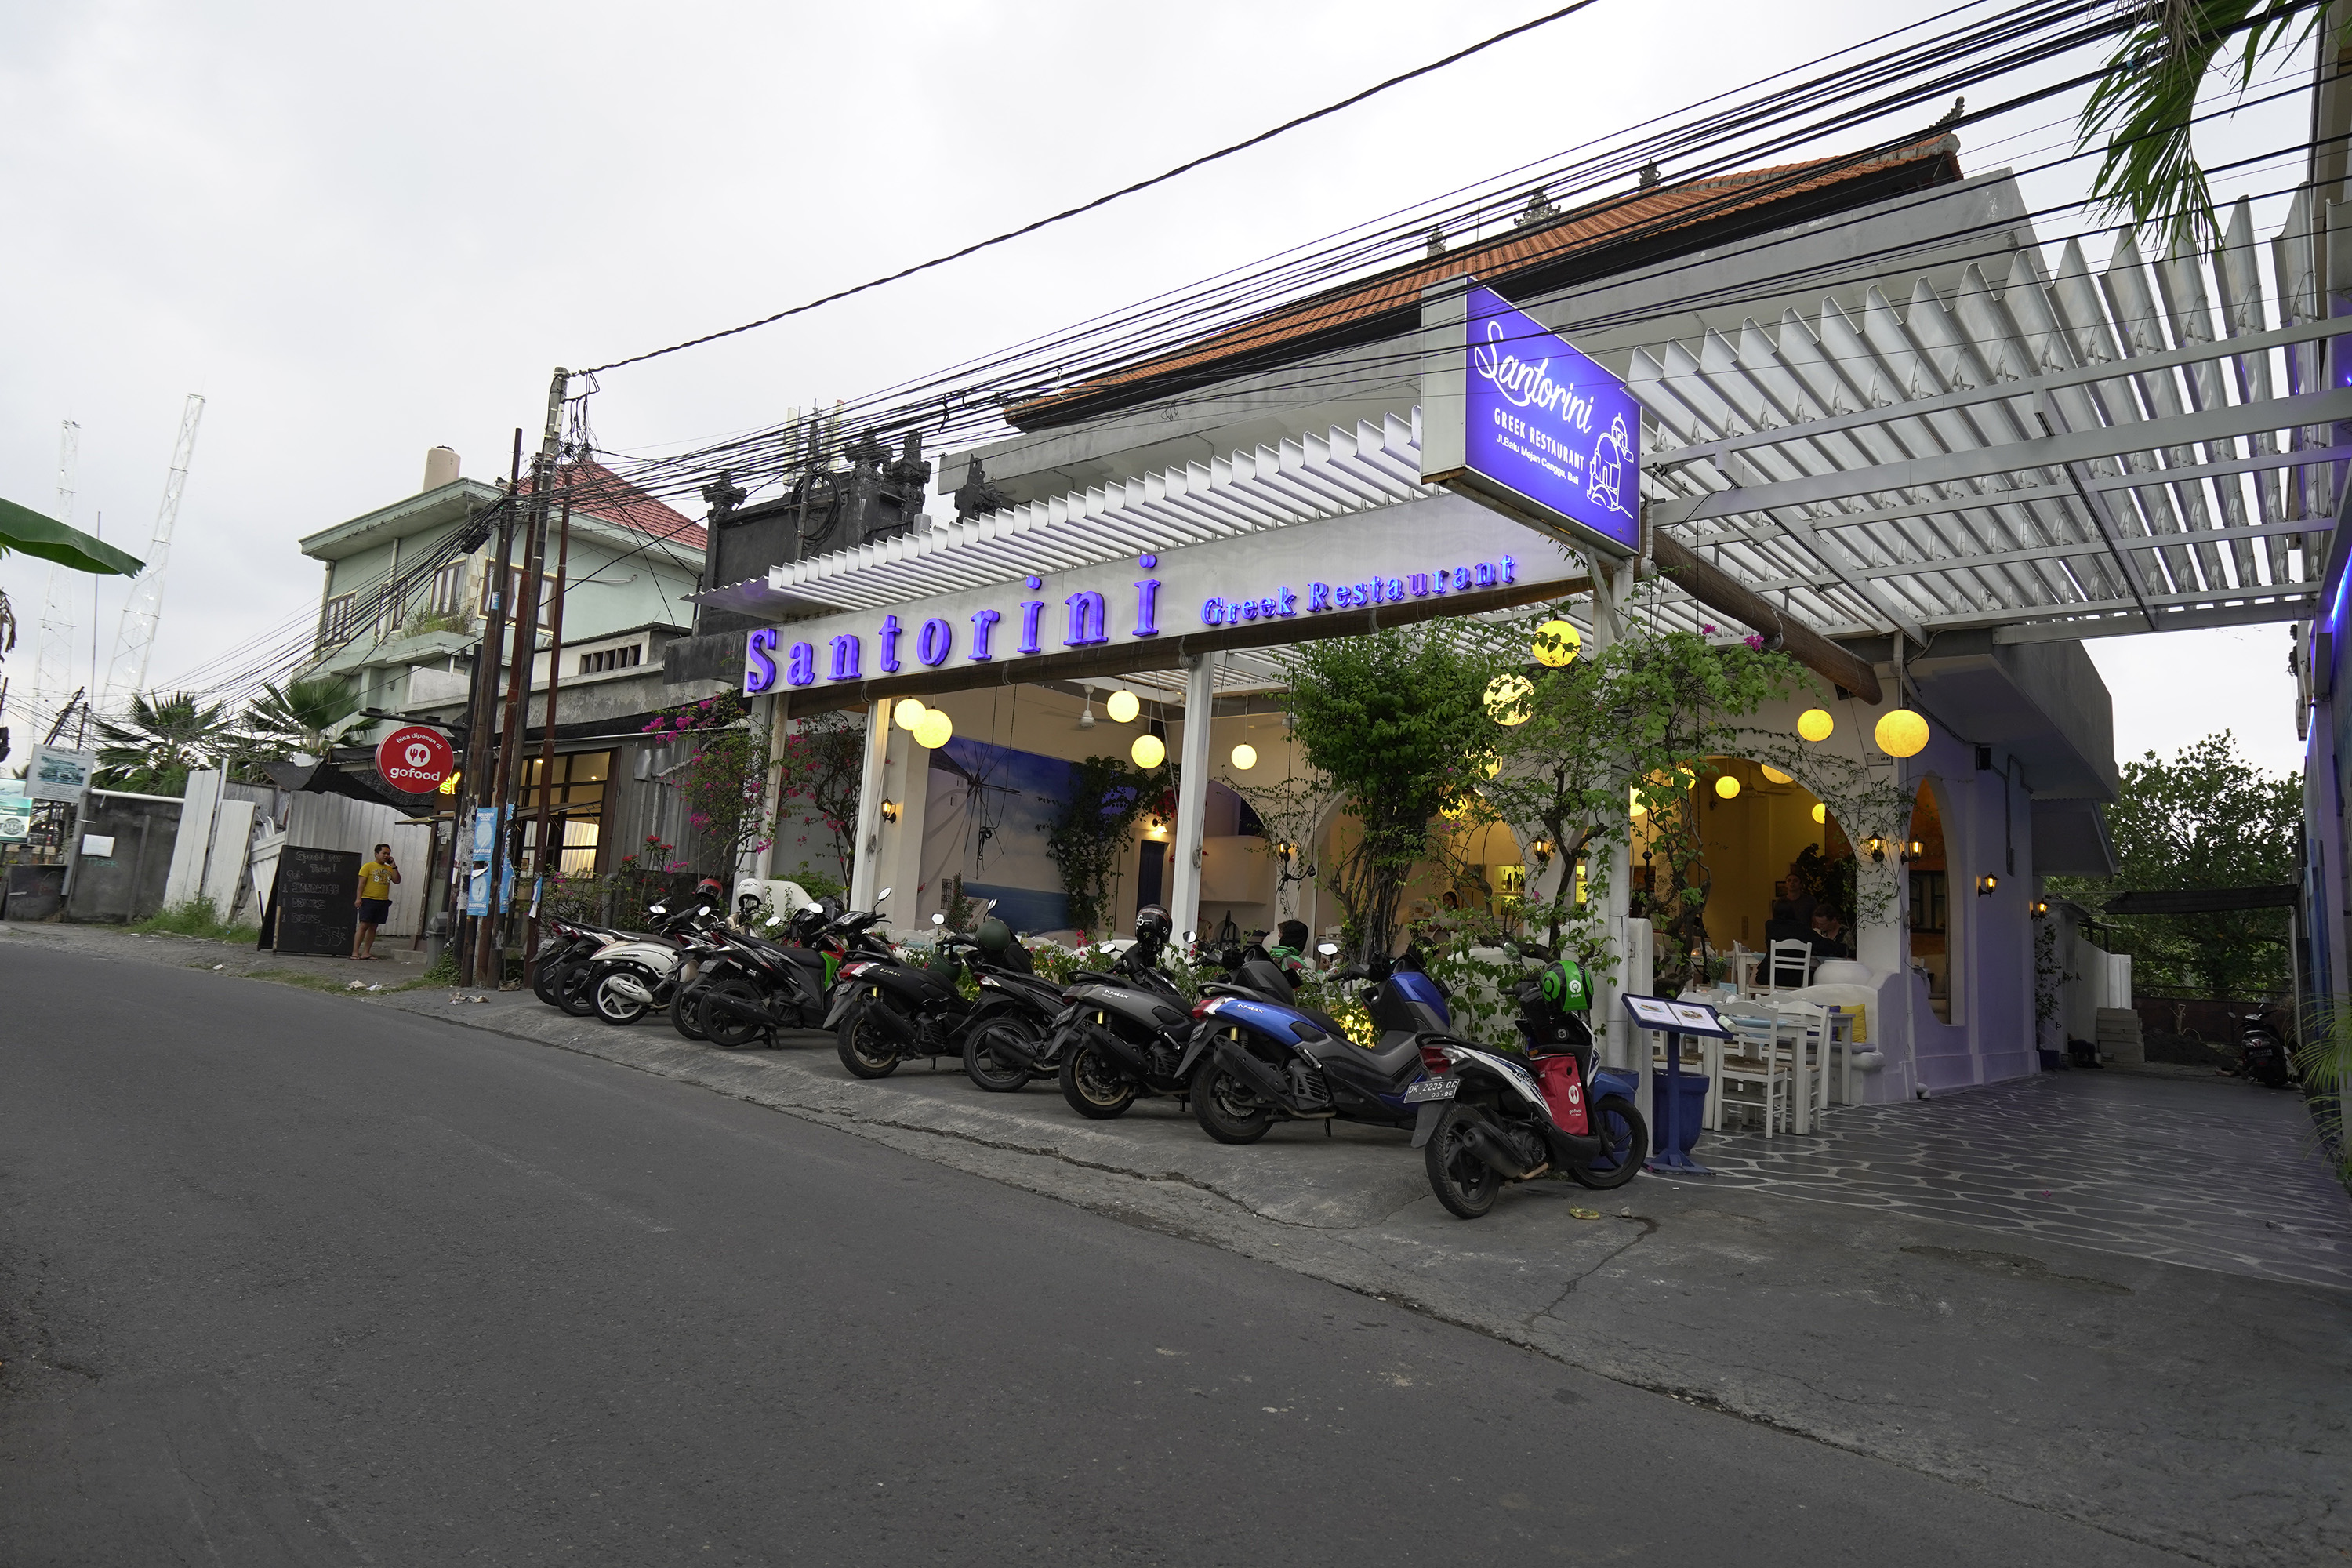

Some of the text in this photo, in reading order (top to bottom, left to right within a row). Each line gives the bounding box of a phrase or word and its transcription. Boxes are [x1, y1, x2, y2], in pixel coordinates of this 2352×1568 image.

[1474, 321, 1595, 434] Santorini
[1494, 408, 1584, 471] GREEK RESTAURANT
[1520, 445, 1541, 464] Mejan
[1567, 471, 1579, 485] Bali
[1200, 554, 1515, 626] Greek Restaurant
[747, 553, 1162, 693] Santorini
[396, 734, 411, 744] Bisa
[411, 732, 437, 745] dipesan
[390, 768, 441, 782] gofood
[1408, 1085, 1419, 1094] DK
[1422, 1082, 1443, 1092] 2235
